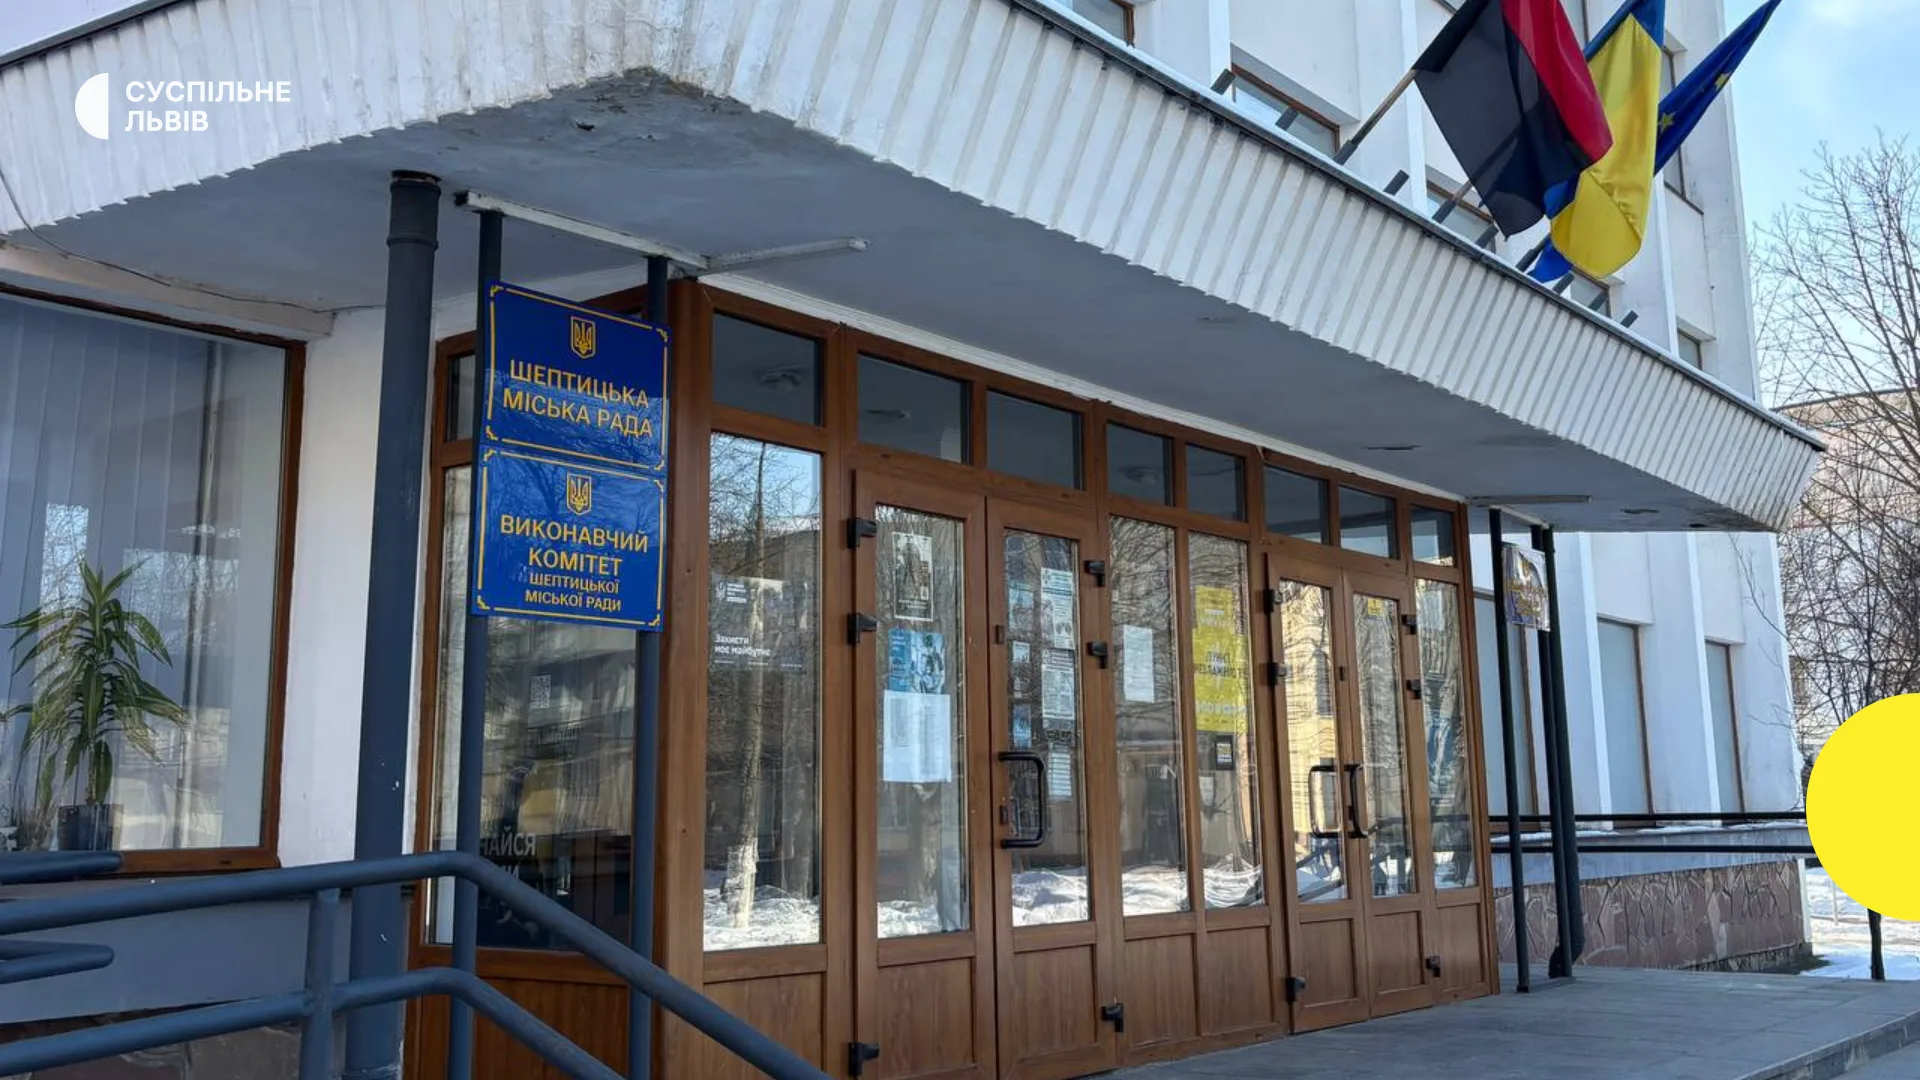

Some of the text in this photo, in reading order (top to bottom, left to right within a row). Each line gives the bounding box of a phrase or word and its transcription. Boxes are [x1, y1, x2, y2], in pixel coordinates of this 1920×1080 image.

[510, 359, 649, 409] ШЕПТИЦЬКА
[503, 388, 653, 438] МІСЬКА РАДА
[500, 514, 648, 553] ВИКОНАВЧИЙ
[529, 548, 623, 576] КОМІТЕТ
[529, 572, 619, 594] ШЕПТИЦЬКОЇ
[525, 590, 622, 612] МІСЬКОЇ РАДИ
